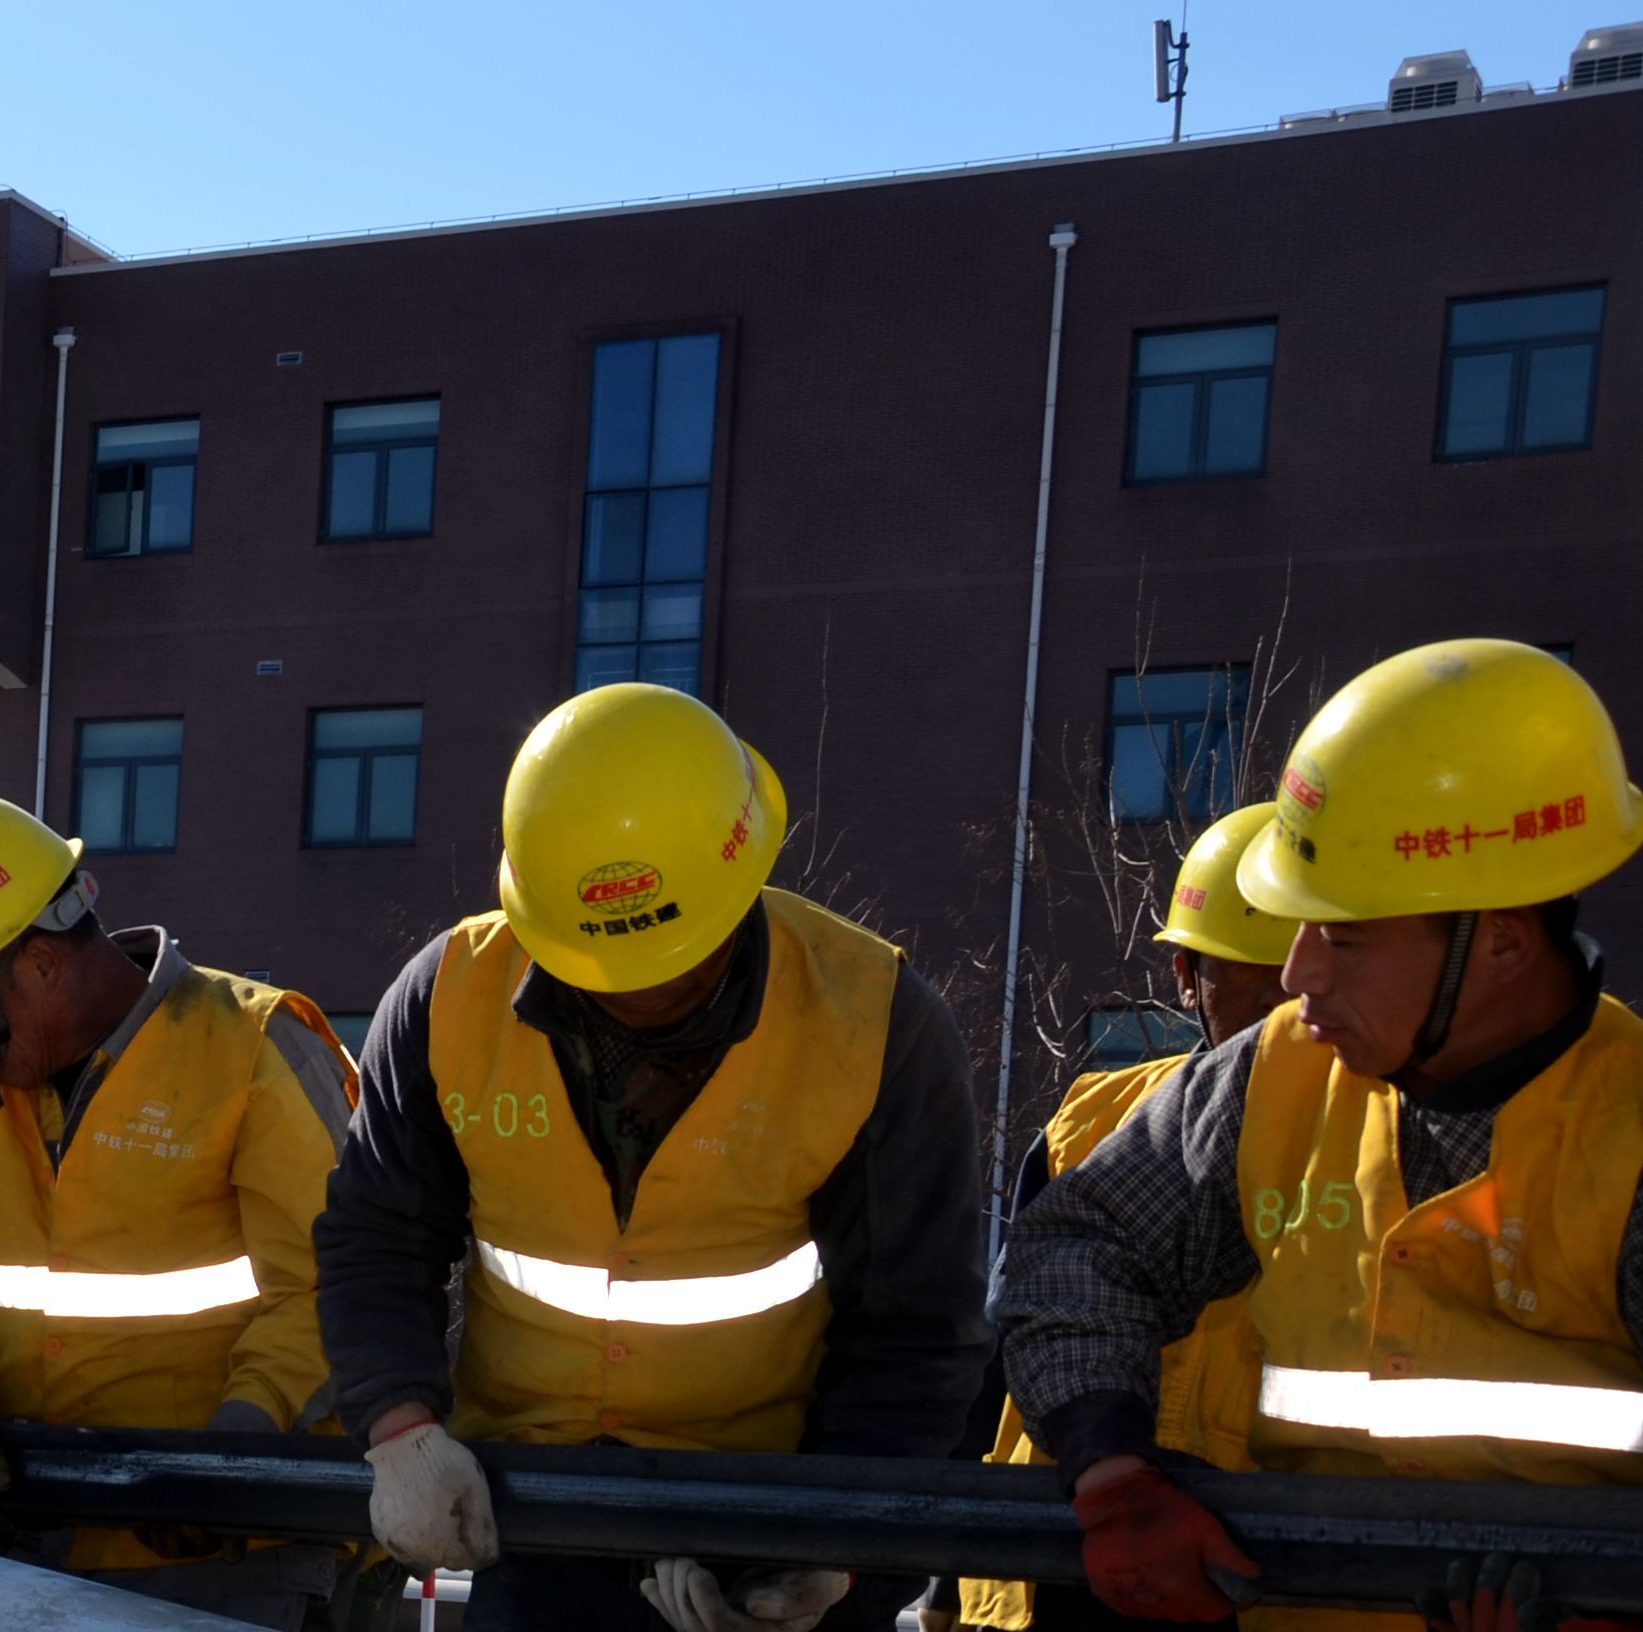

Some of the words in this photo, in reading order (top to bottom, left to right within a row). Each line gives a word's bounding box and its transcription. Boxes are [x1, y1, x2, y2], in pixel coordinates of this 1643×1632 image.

[1395, 795, 1586, 861] 中铁十一局集团
[580, 902, 682, 937] 中国铁建
[93, 1131, 196, 1159] 中铁十一局集团
